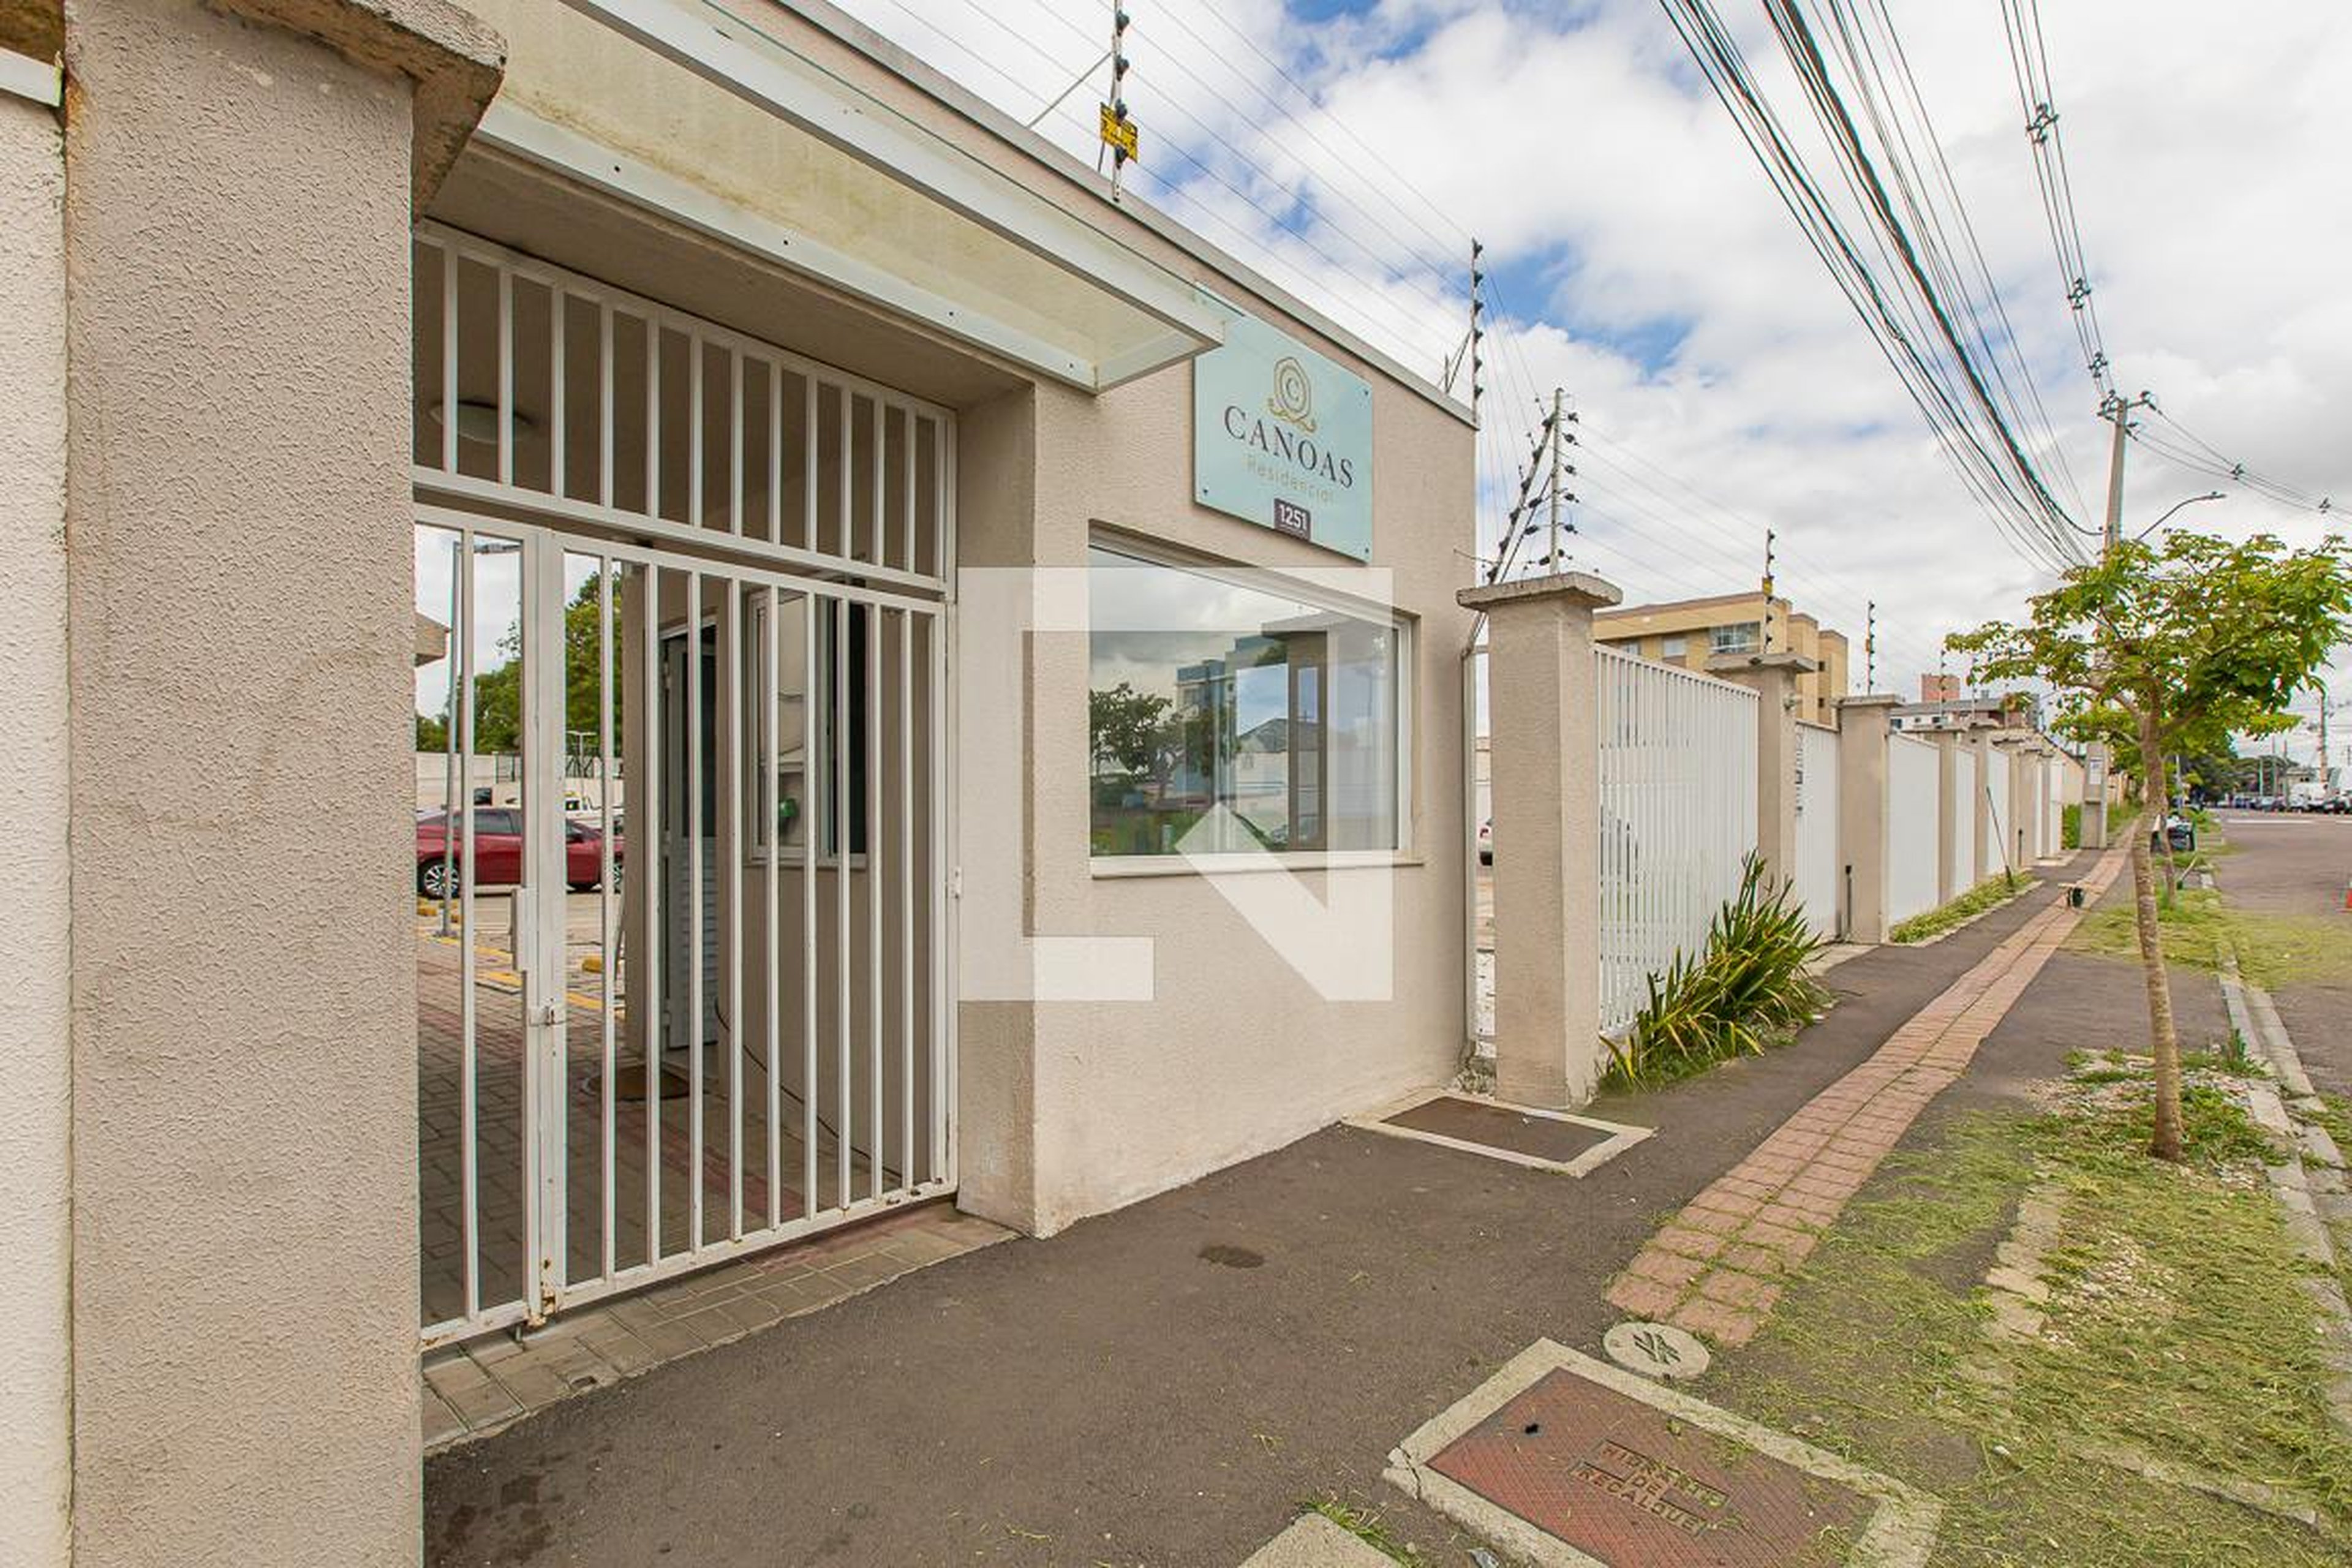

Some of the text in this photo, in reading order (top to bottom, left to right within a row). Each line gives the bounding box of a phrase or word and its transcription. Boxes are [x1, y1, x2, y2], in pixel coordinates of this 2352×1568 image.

[1225, 405, 1354, 489] CANOAS
[1279, 503, 1307, 532] 1251
[1578, 1470, 1699, 1531] RECALQUE
[1632, 1475, 1662, 1496] DE
